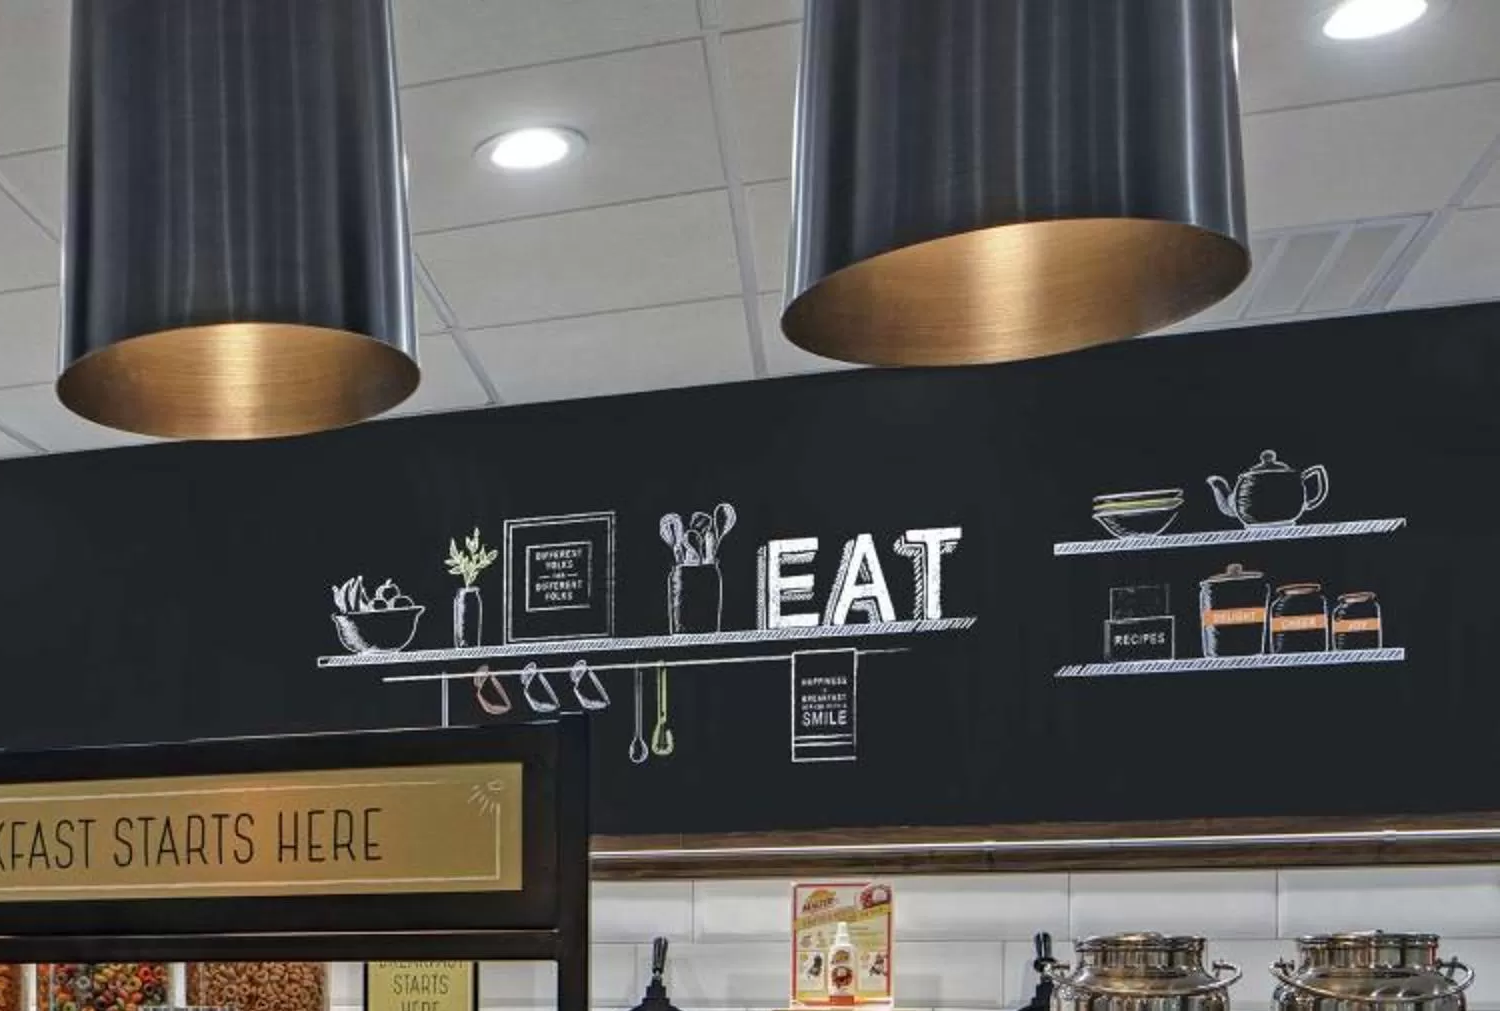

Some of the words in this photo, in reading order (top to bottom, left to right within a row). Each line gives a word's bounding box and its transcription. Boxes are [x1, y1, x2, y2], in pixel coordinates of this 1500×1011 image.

[759, 527, 963, 630] EAT
[1114, 632, 1165, 646] RECIPES
[802, 710, 847, 727] SMILE
[113, 812, 255, 868] STARTS
[278, 807, 384, 863] HERE
[393, 973, 450, 996] STARTS
